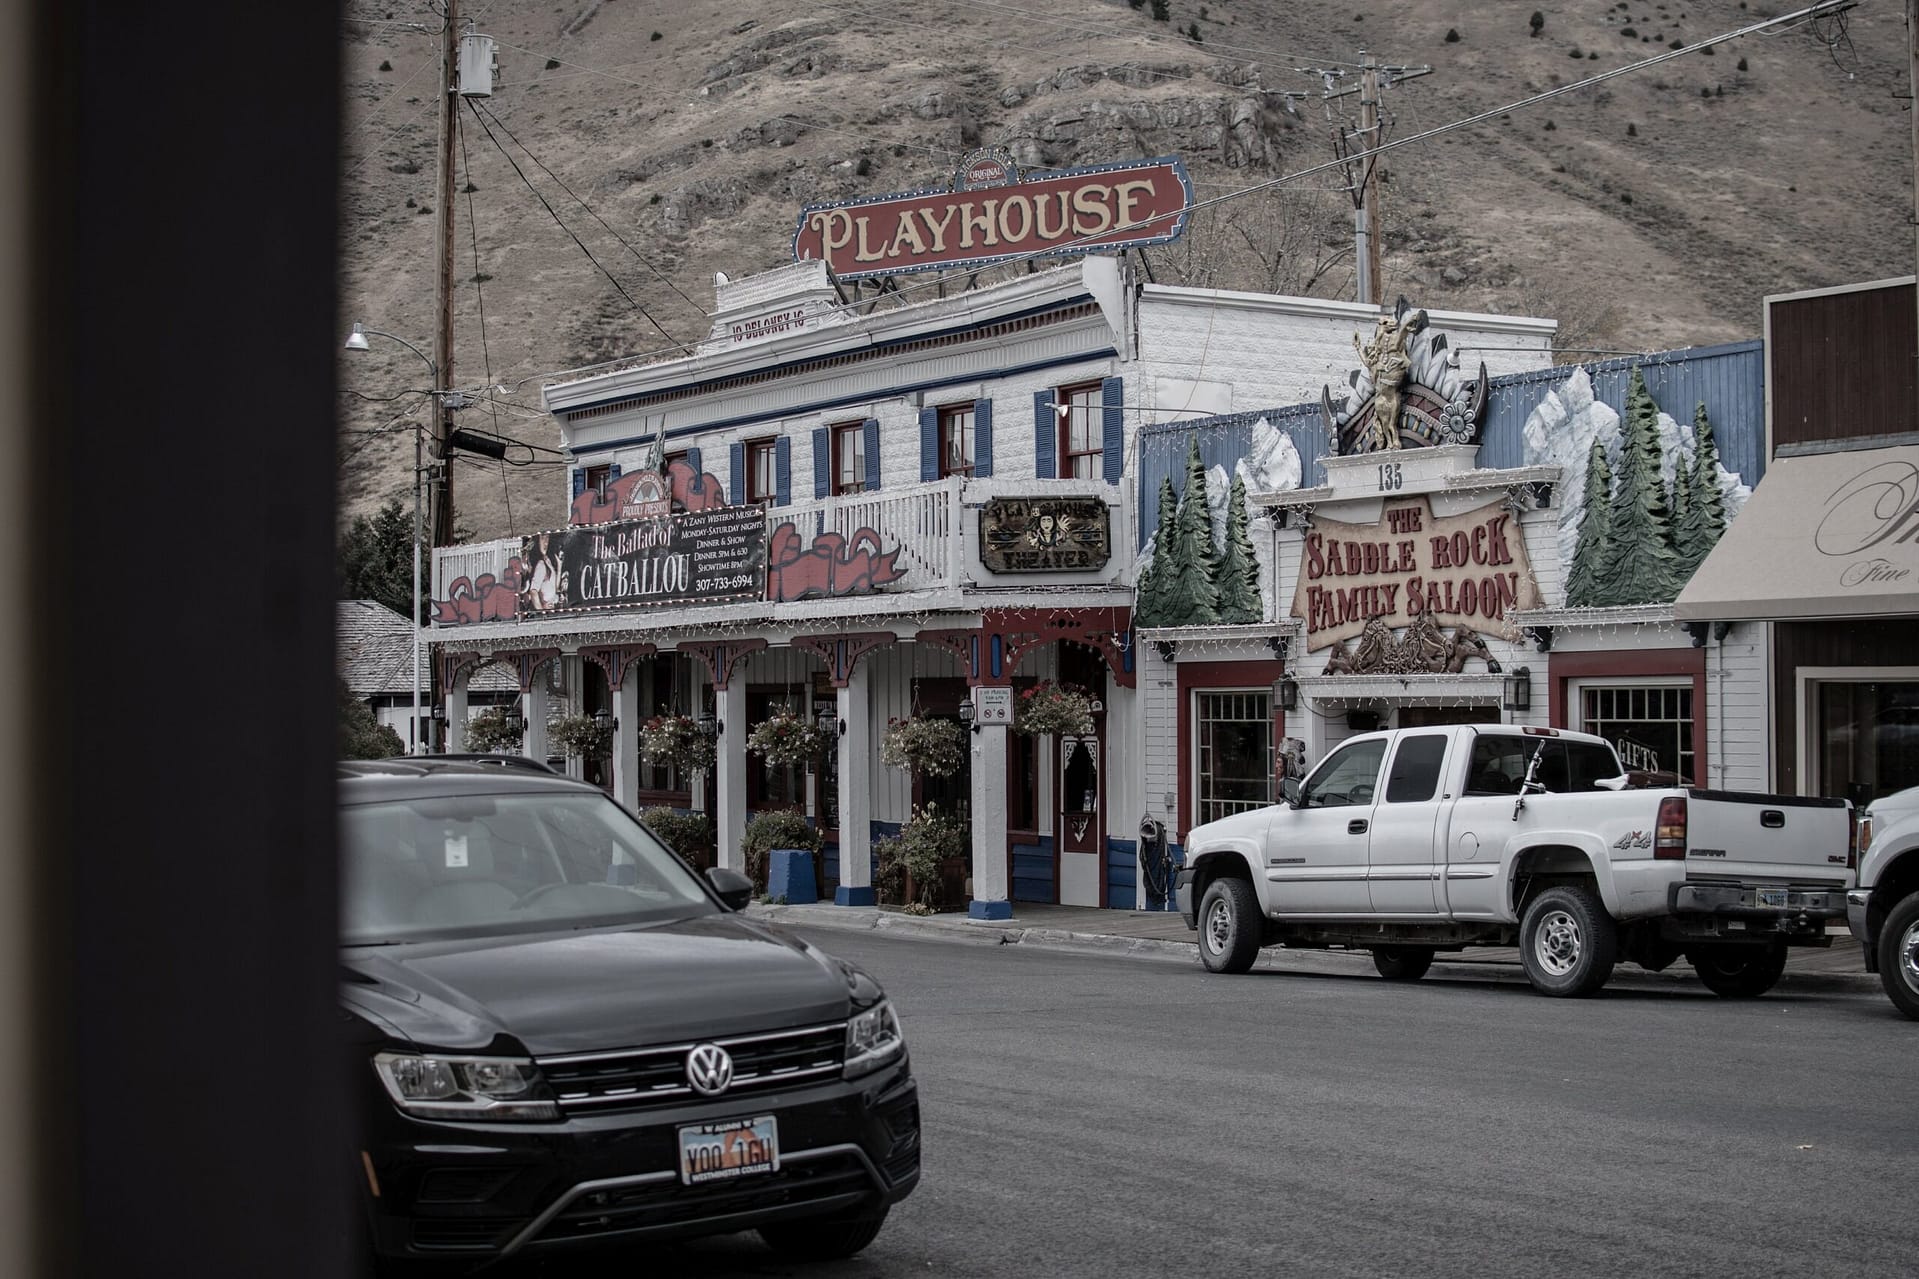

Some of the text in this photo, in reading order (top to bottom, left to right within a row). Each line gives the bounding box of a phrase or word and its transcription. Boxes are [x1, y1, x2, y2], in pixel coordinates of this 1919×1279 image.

[970, 167, 1003, 181] ORIGINAL
[811, 179, 1156, 268] PLAYHOUSE
[1378, 463, 1403, 491] 135
[682, 510, 761, 527] A ZANY WESTERN MUSIC
[740, 521, 763, 531] NIGHTS
[1387, 507, 1423, 534] THE
[592, 524, 674, 559] The Ballad of
[696, 539, 720, 549] DINNER
[727, 535, 746, 546] SHOW
[1305, 513, 1513, 580] SADDLE ROCK
[694, 551, 717, 561] DINNER
[698, 562, 730, 573] SHOWTIME
[1840, 558, 1911, 588] Fine
[695, 574, 753, 592] 307-733-6994
[1306, 572, 1519, 634] FAMILY SALOON
[1617, 738, 1659, 774] GIFTS
[1828, 855, 1847, 864] GMC
[692, 1162, 771, 1182] WESTMINSTER COLLEGE
